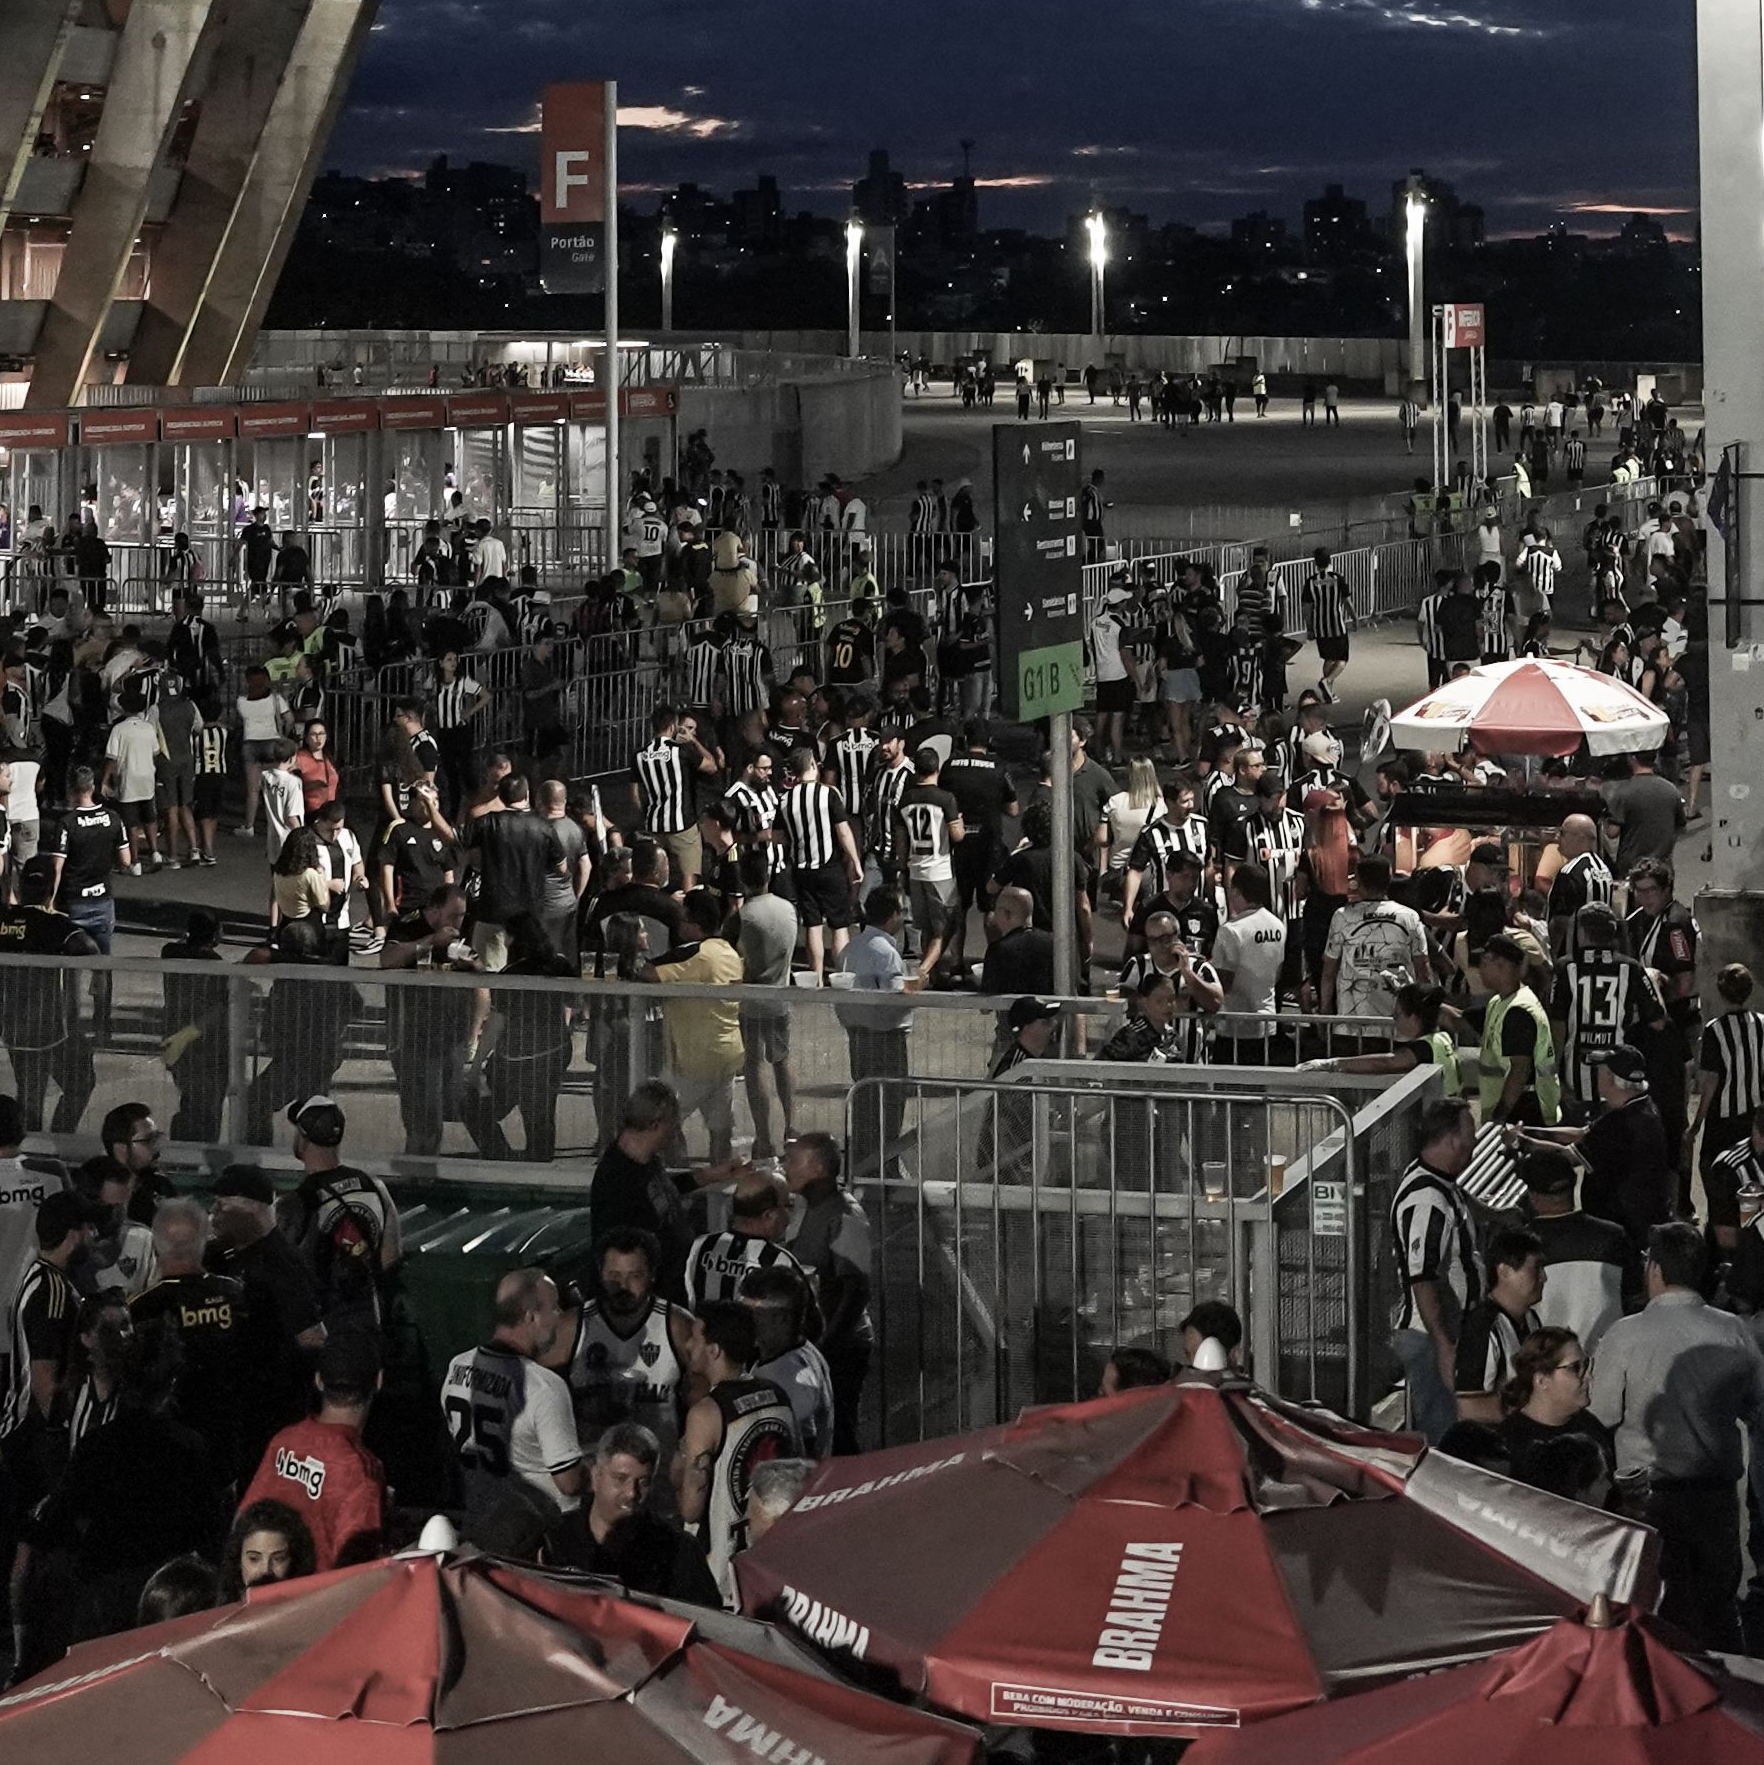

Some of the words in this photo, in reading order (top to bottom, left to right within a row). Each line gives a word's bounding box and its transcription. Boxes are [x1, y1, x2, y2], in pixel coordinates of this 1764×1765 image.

[556, 151, 590, 209] F
[550, 235, 595, 250] Portão
[572, 251, 595, 264] Gate
[644, 525, 661, 542] 10
[834, 642, 854, 669] 10
[85, 813, 111, 828] bmg
[908, 806, 933, 841] 12
[0, 920, 27, 940] bmg
[1255, 929, 1283, 944] GALO
[1577, 975, 1619, 1027] 13
[180, 1304, 234, 1331] bmg
[443, 1393, 510, 1476] 25
[287, 1457, 325, 1497] bmg
[792, 1453, 965, 1514] BRAHMA
[1091, 1541, 1185, 1672] BRAHMA
[1002, 1690, 1030, 1703] BEBA
[1031, 1693, 1056, 1707] COM
[1126, 1705, 1164, 1718] VENDA
